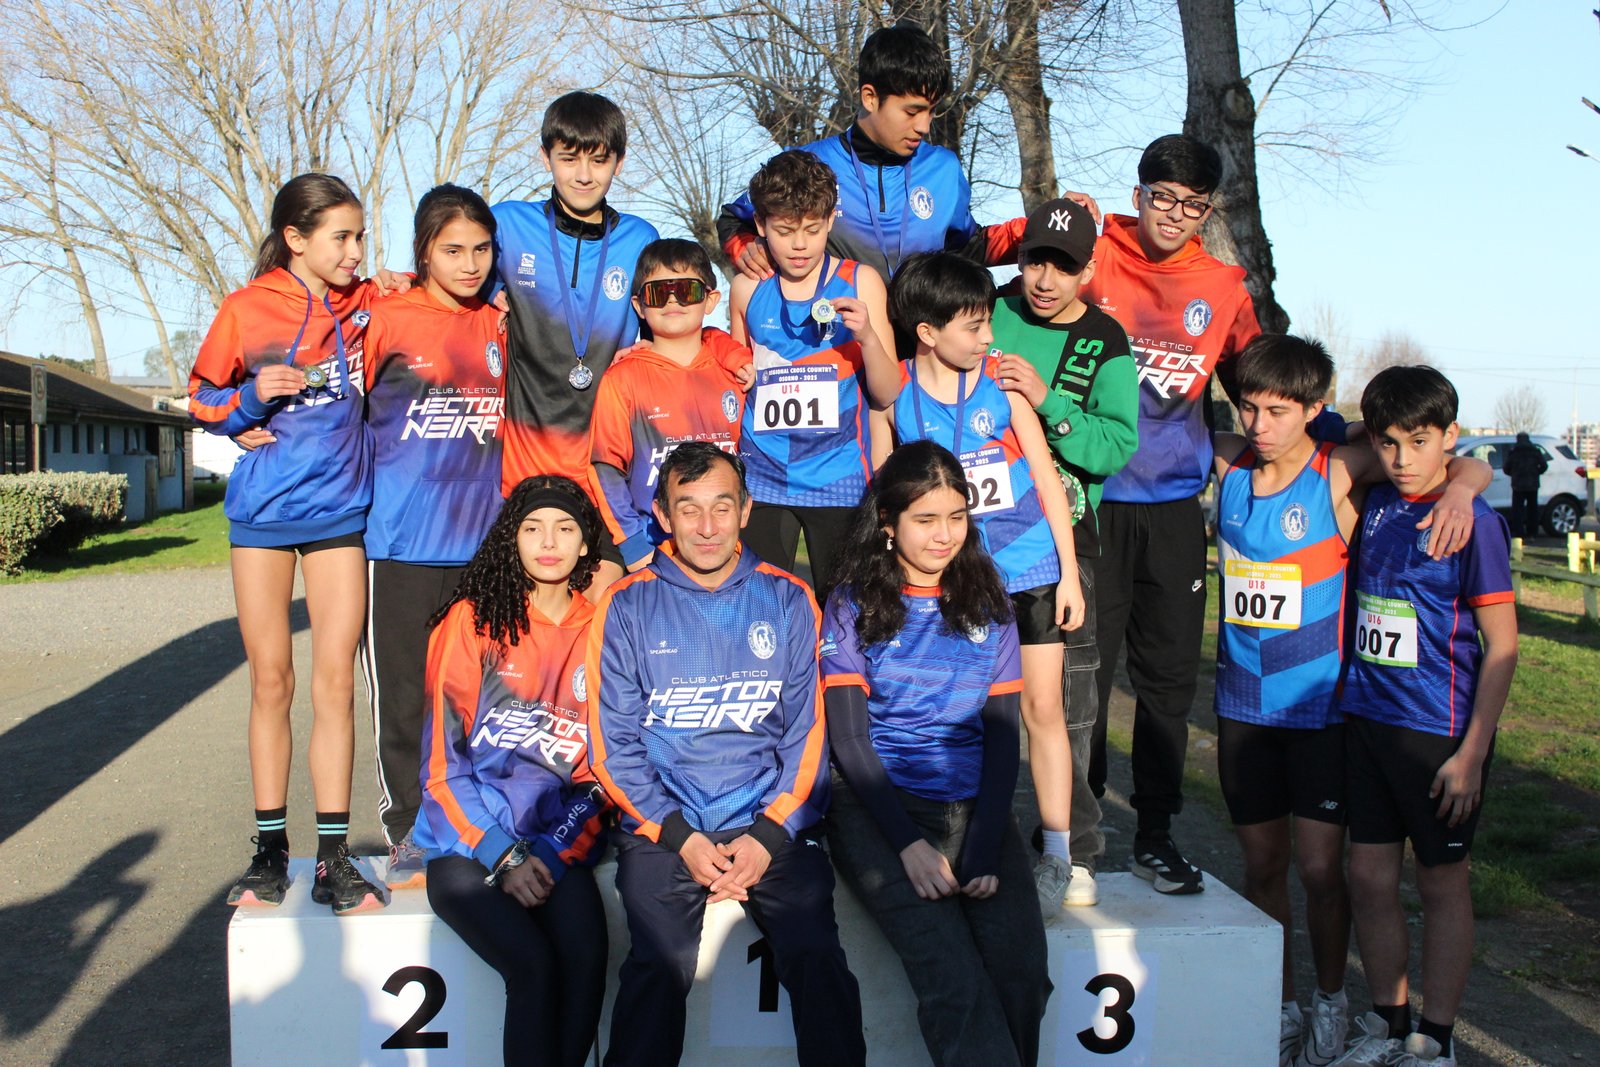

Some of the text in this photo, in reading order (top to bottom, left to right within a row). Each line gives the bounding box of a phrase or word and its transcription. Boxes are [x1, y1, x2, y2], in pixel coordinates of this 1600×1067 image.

[1048, 209, 1072, 231] NY
[1137, 337, 1193, 352] ATLETICO
[1054, 337, 1104, 402] TICS
[781, 384, 800, 394] U14
[406, 397, 505, 418] HECTOR
[764, 398, 823, 428] 001
[665, 432, 731, 443] CLUB ATLETIC
[959, 448, 1000, 460] CROSS COUNTRY
[967, 477, 1001, 510] 02
[1248, 580, 1266, 590] U18
[1234, 591, 1287, 620] 007
[1367, 613, 1382, 625] U16
[1358, 625, 1402, 658] 007
[672, 670, 768, 685] CLUB ATLETICO
[648, 681, 783, 706] HECTOR
[541, 701, 579, 718] ATLETICO
[644, 701, 777, 733] NEIRA
[747, 937, 779, 1012] 1
[381, 966, 448, 1050] 2
[1076, 973, 1135, 1055] 3
